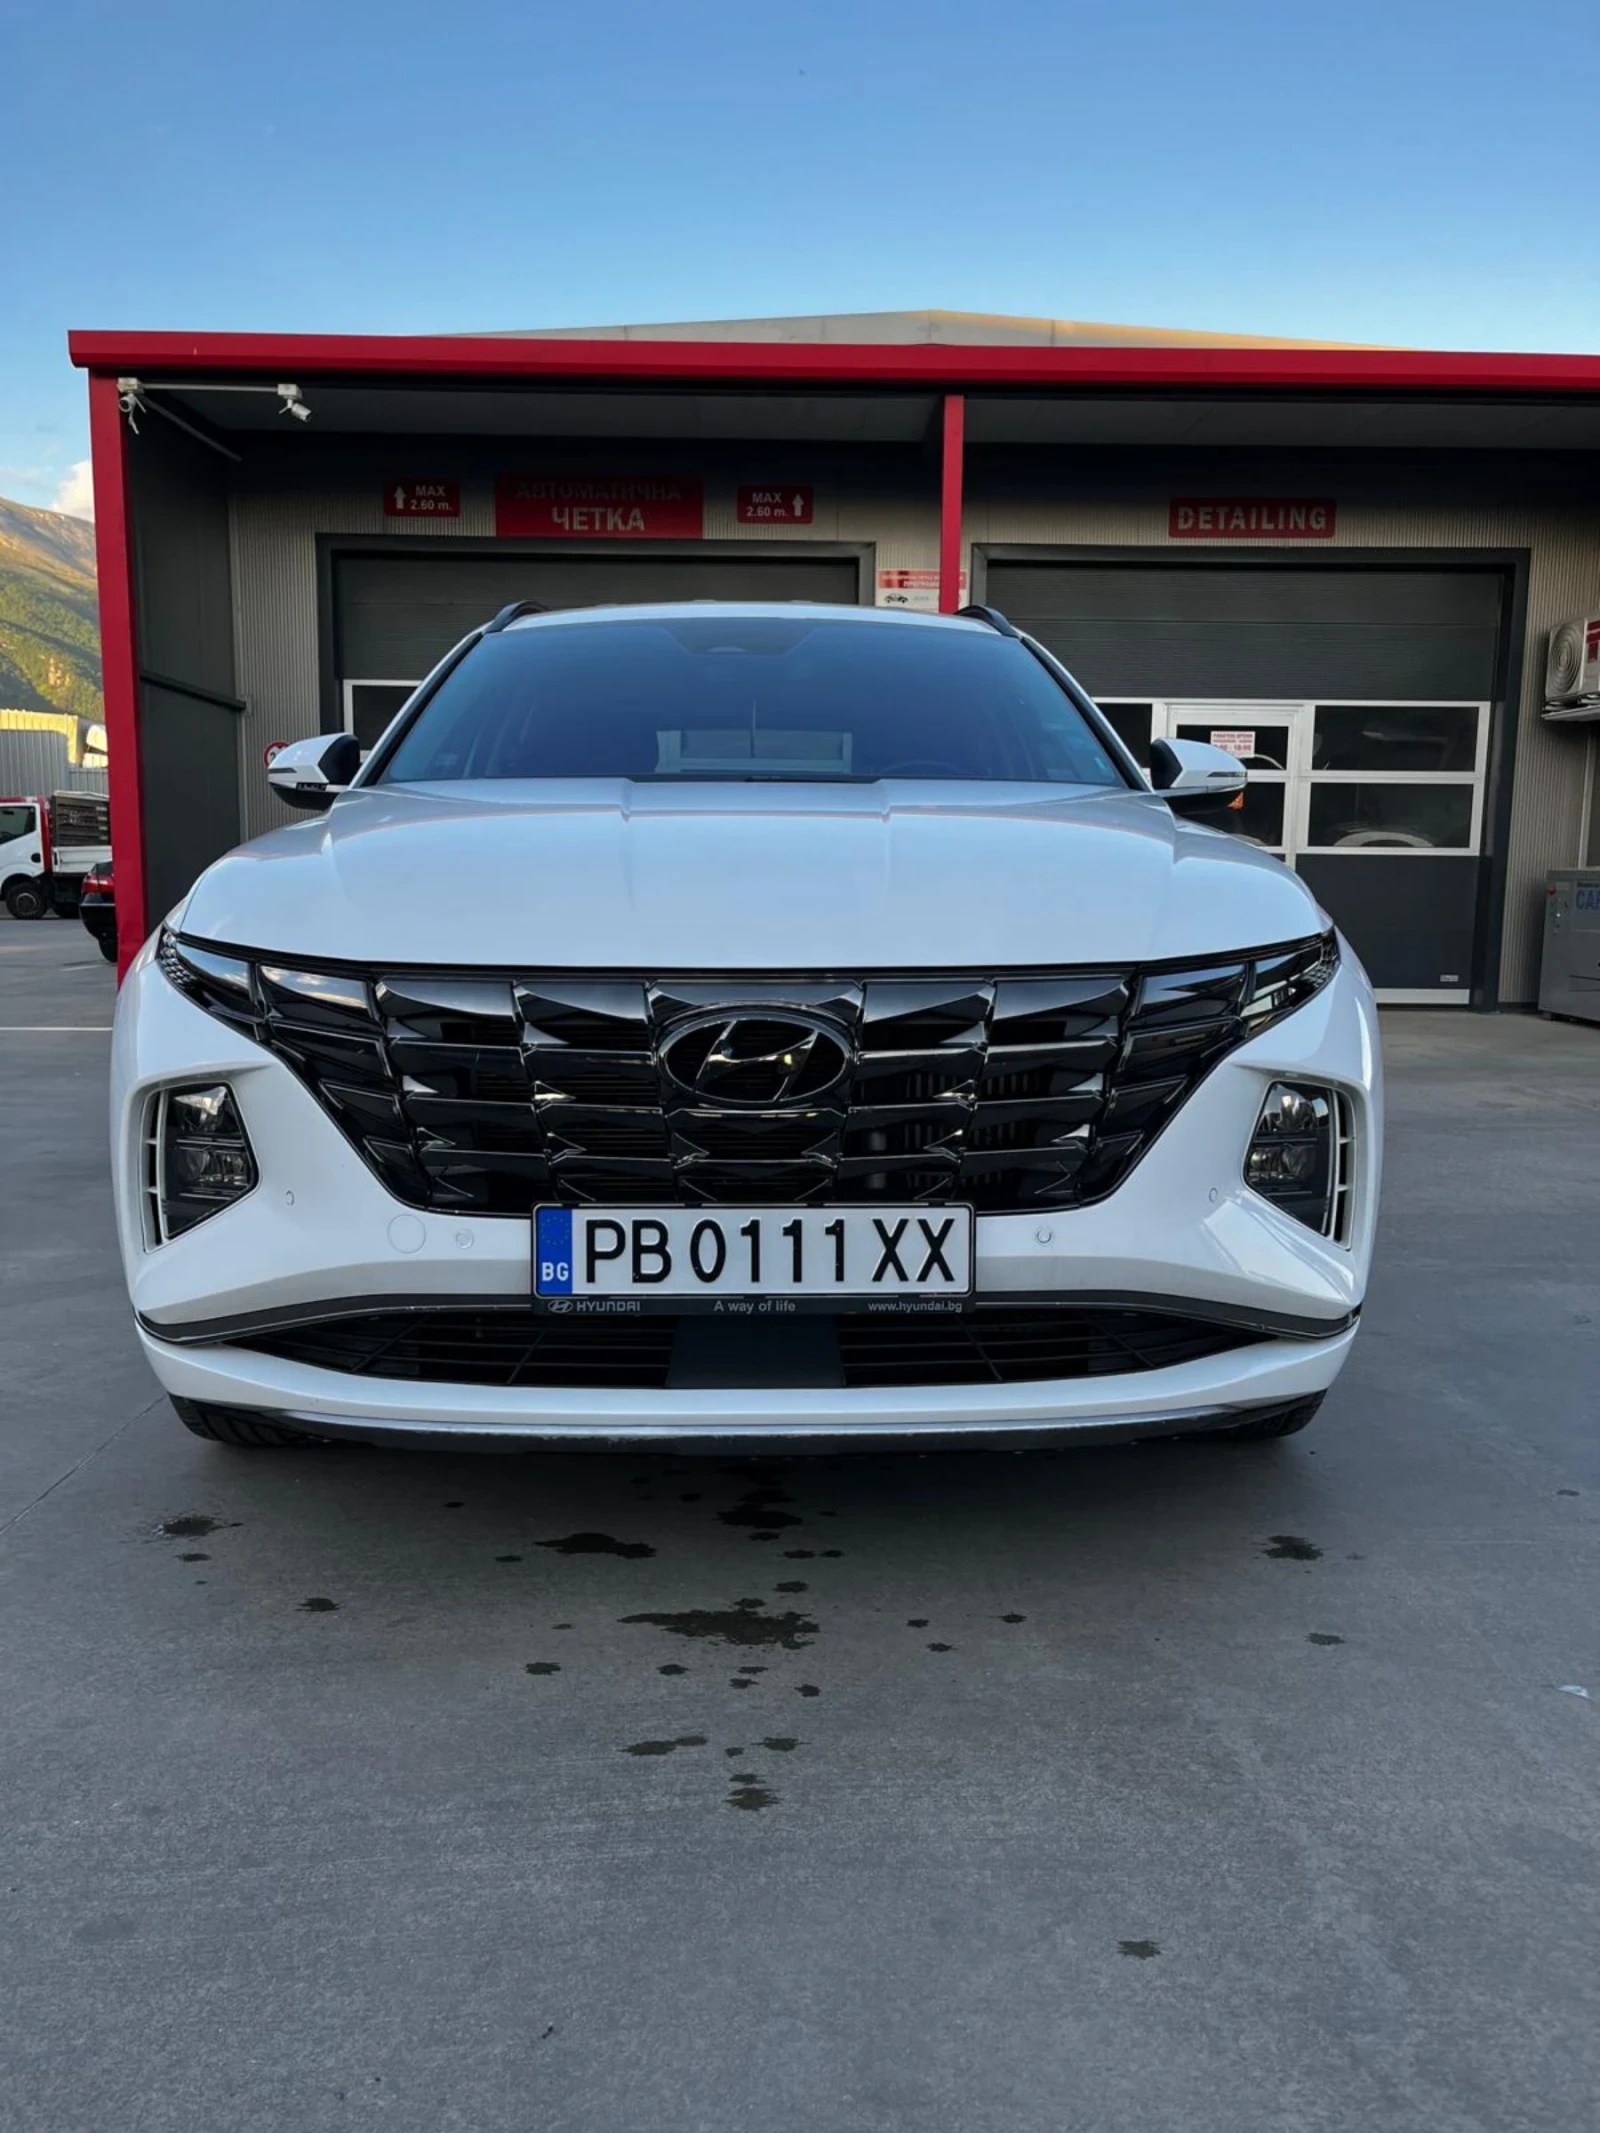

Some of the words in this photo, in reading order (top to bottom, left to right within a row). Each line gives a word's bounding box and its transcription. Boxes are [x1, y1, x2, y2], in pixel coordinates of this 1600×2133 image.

[415, 484, 446, 497] MAX
[515, 481, 682, 501] АВТОМАТИЧНА
[410, 499, 435, 511] 2.60
[752, 492, 782, 504] MAX
[551, 505, 645, 532] ЧЕТКА
[746, 506, 771, 517] 2.60
[1176, 506, 1327, 531] DETAILING
[585, 1218, 672, 1284] PB
[690, 1217, 845, 1284] 0111
[871, 1217, 956, 1283] XX
[541, 1262, 569, 1282] BG
[576, 1301, 640, 1312] HYUNDAI
[713, 1300, 724, 1312] A
[727, 1302, 754, 1315] way
[758, 1300, 772, 1312] of
[775, 1300, 796, 1312] life
[867, 1300, 962, 1314] www.hyundai.bg
